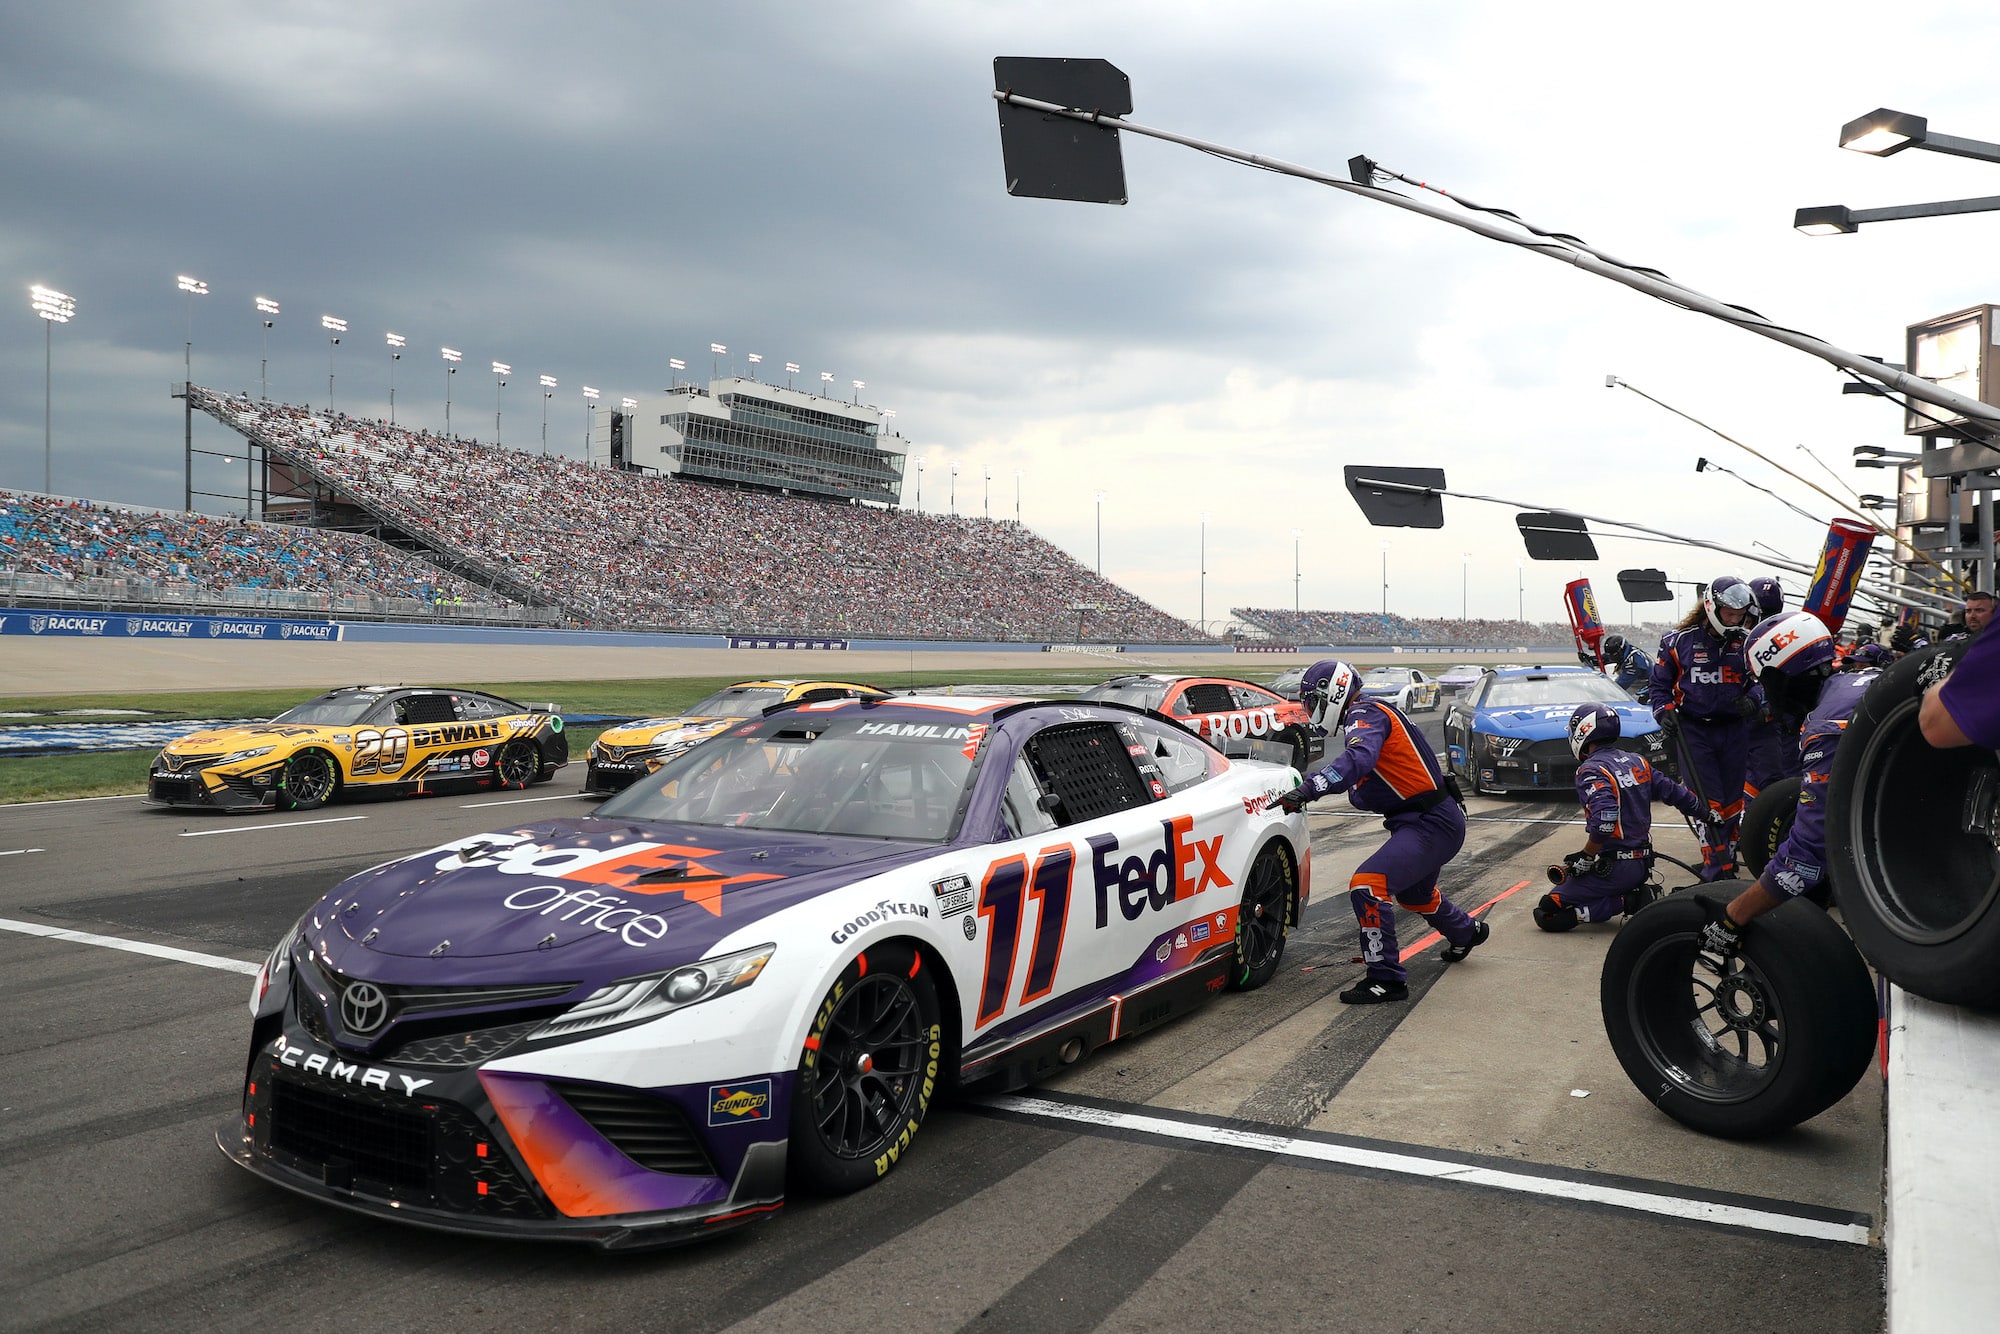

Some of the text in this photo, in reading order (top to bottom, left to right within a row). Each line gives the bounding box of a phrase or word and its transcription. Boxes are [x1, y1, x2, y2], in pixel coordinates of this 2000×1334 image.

[48, 618, 108, 631] RACKLEY
[142, 620, 193, 633] RACKLEY
[222, 624, 267, 635] RACKLEY
[292, 626, 332, 636] RACKLEY
[1754, 630, 1800, 667] FedEx
[1690, 666, 1742, 684] FedEx
[1329, 672, 1350, 705] FedEx
[508, 718, 537, 730] yahoo!
[856, 723, 971, 739] HAMLIN
[351, 728, 409, 776] 20
[1502, 748, 1515, 757] 17
[598, 762, 636, 770] CAMRY
[1767, 817, 1782, 859] EAGLE
[1617, 850, 1644, 859] FedEx
[1085, 813, 1234, 929] FedEx
[943, 878, 964, 893] NASCAR
[951, 892, 968, 906] SERIES
[504, 886, 668, 947] Office
[831, 900, 929, 945] GOODYEAR
[974, 842, 1076, 1031] 11
[1360, 902, 1384, 963] FedEx
[1205, 975, 1226, 992] TRD
[280, 1046, 434, 1097] CAMRY
[715, 1095, 766, 1112] SUNOCO
[874, 1024, 940, 1177] GOODYEAR
